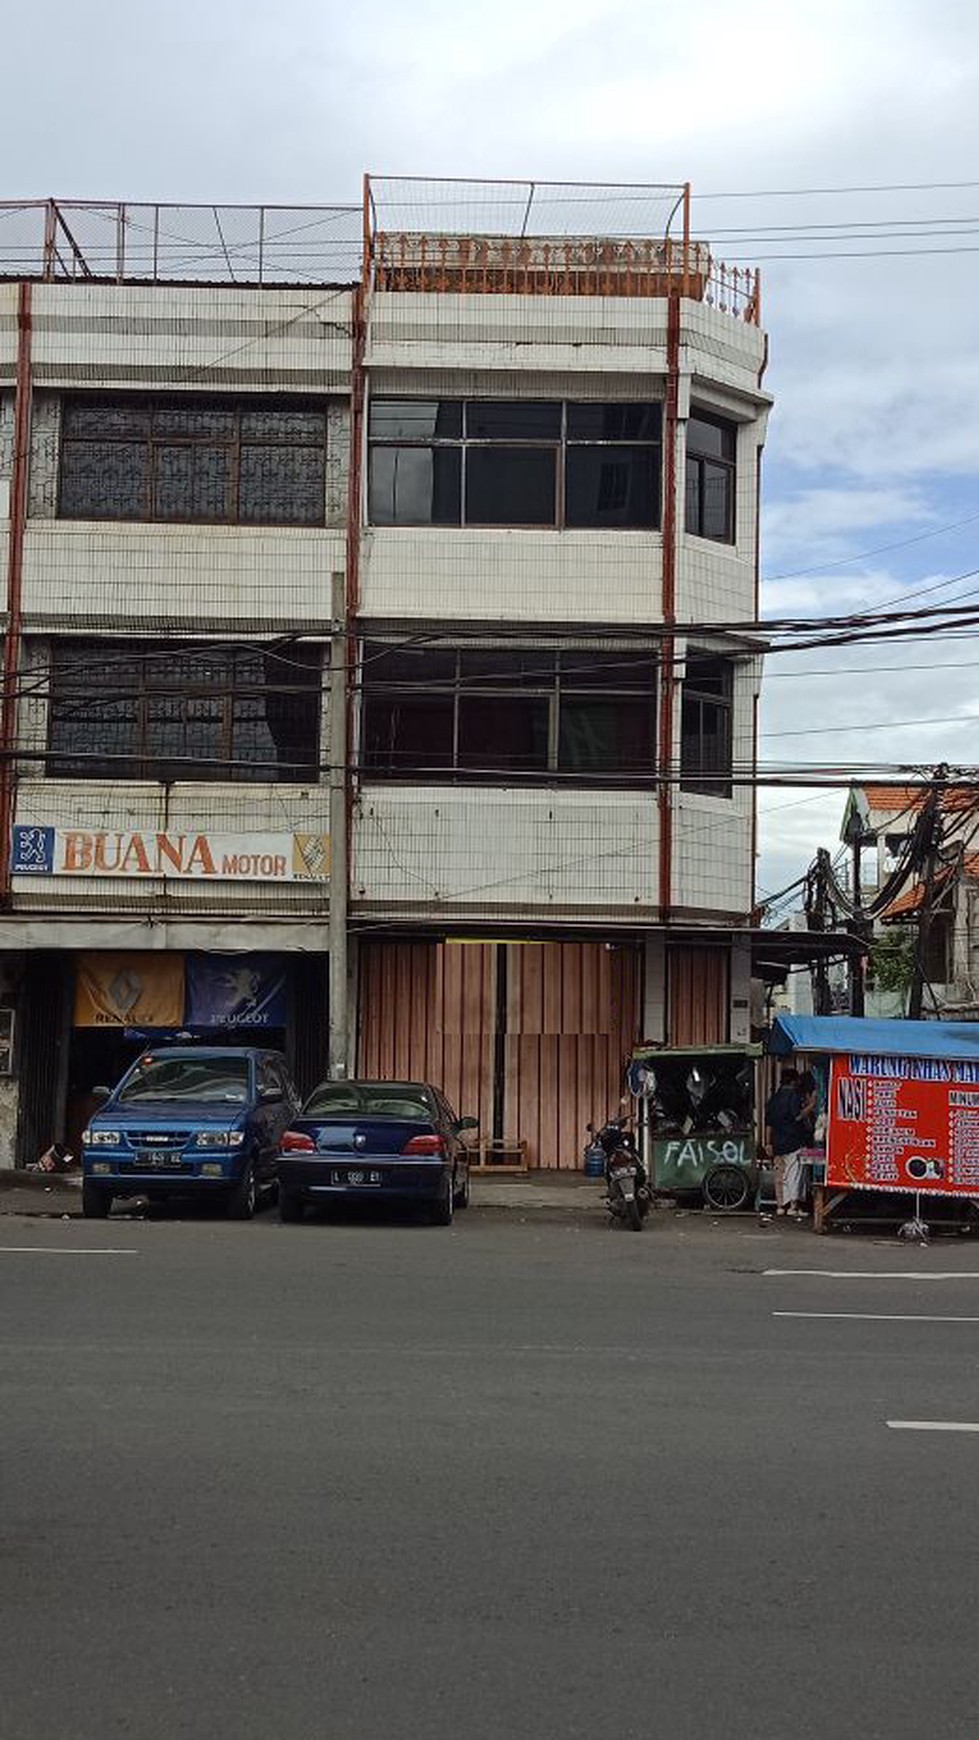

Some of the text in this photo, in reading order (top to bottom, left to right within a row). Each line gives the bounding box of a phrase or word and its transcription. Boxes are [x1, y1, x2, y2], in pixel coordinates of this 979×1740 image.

[61, 831, 286, 876] BUANA MOTOR
[210, 1013, 269, 1024] PEUGEOT
[838, 1077, 867, 1121] NASI
[664, 1139, 752, 1167] FAISOL
